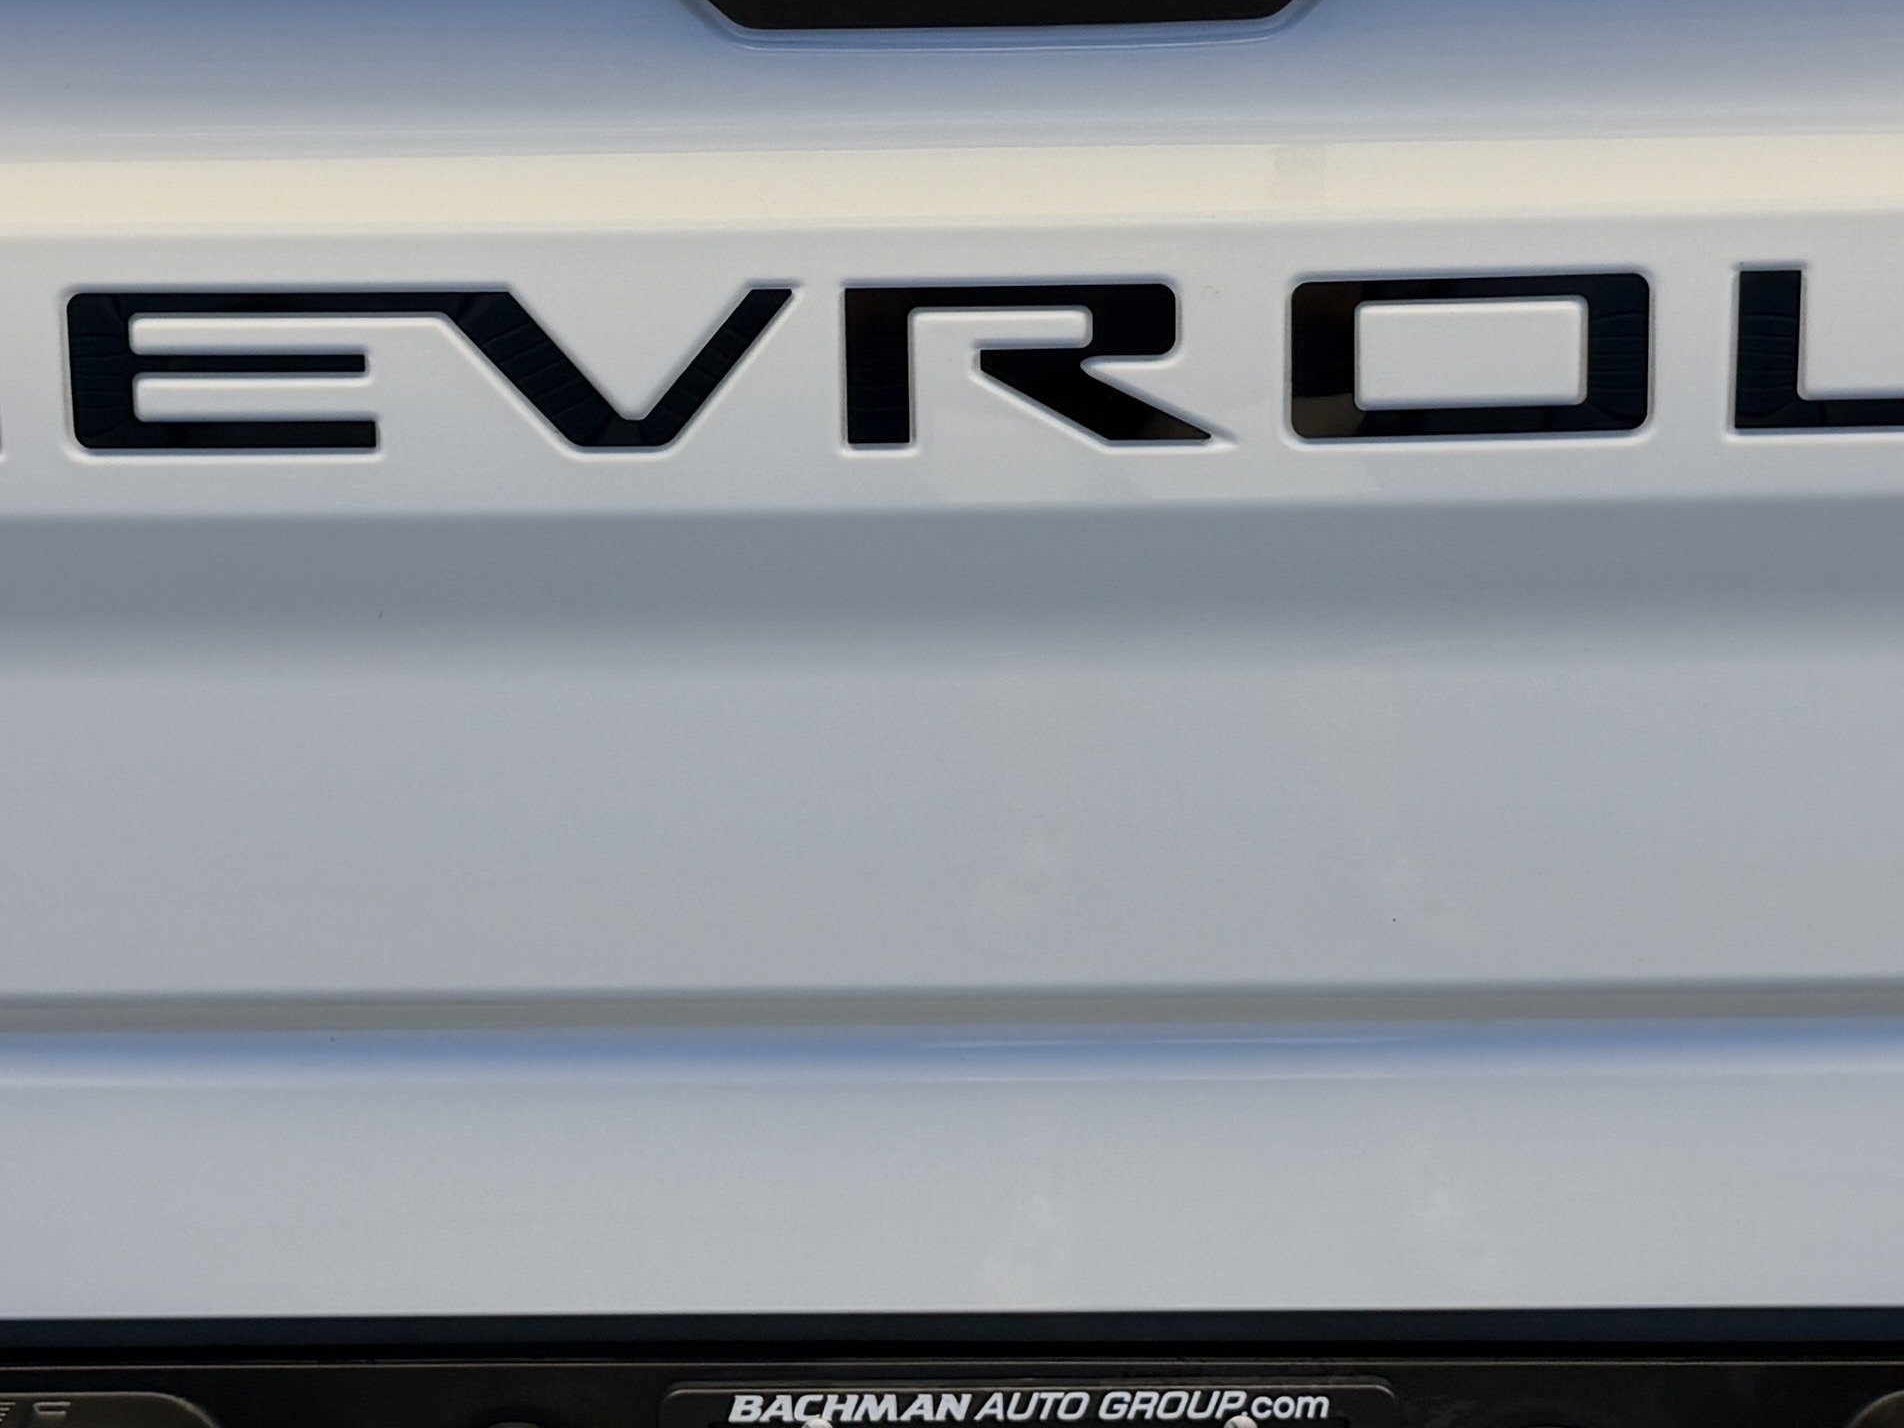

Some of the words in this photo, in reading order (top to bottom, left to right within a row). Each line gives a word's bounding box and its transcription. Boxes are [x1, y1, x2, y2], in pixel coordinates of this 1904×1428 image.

[728, 1394, 973, 1423] BACHMAN
[974, 1392, 1090, 1421] AUTO
[1098, 1389, 1331, 1421] GROUP.com
